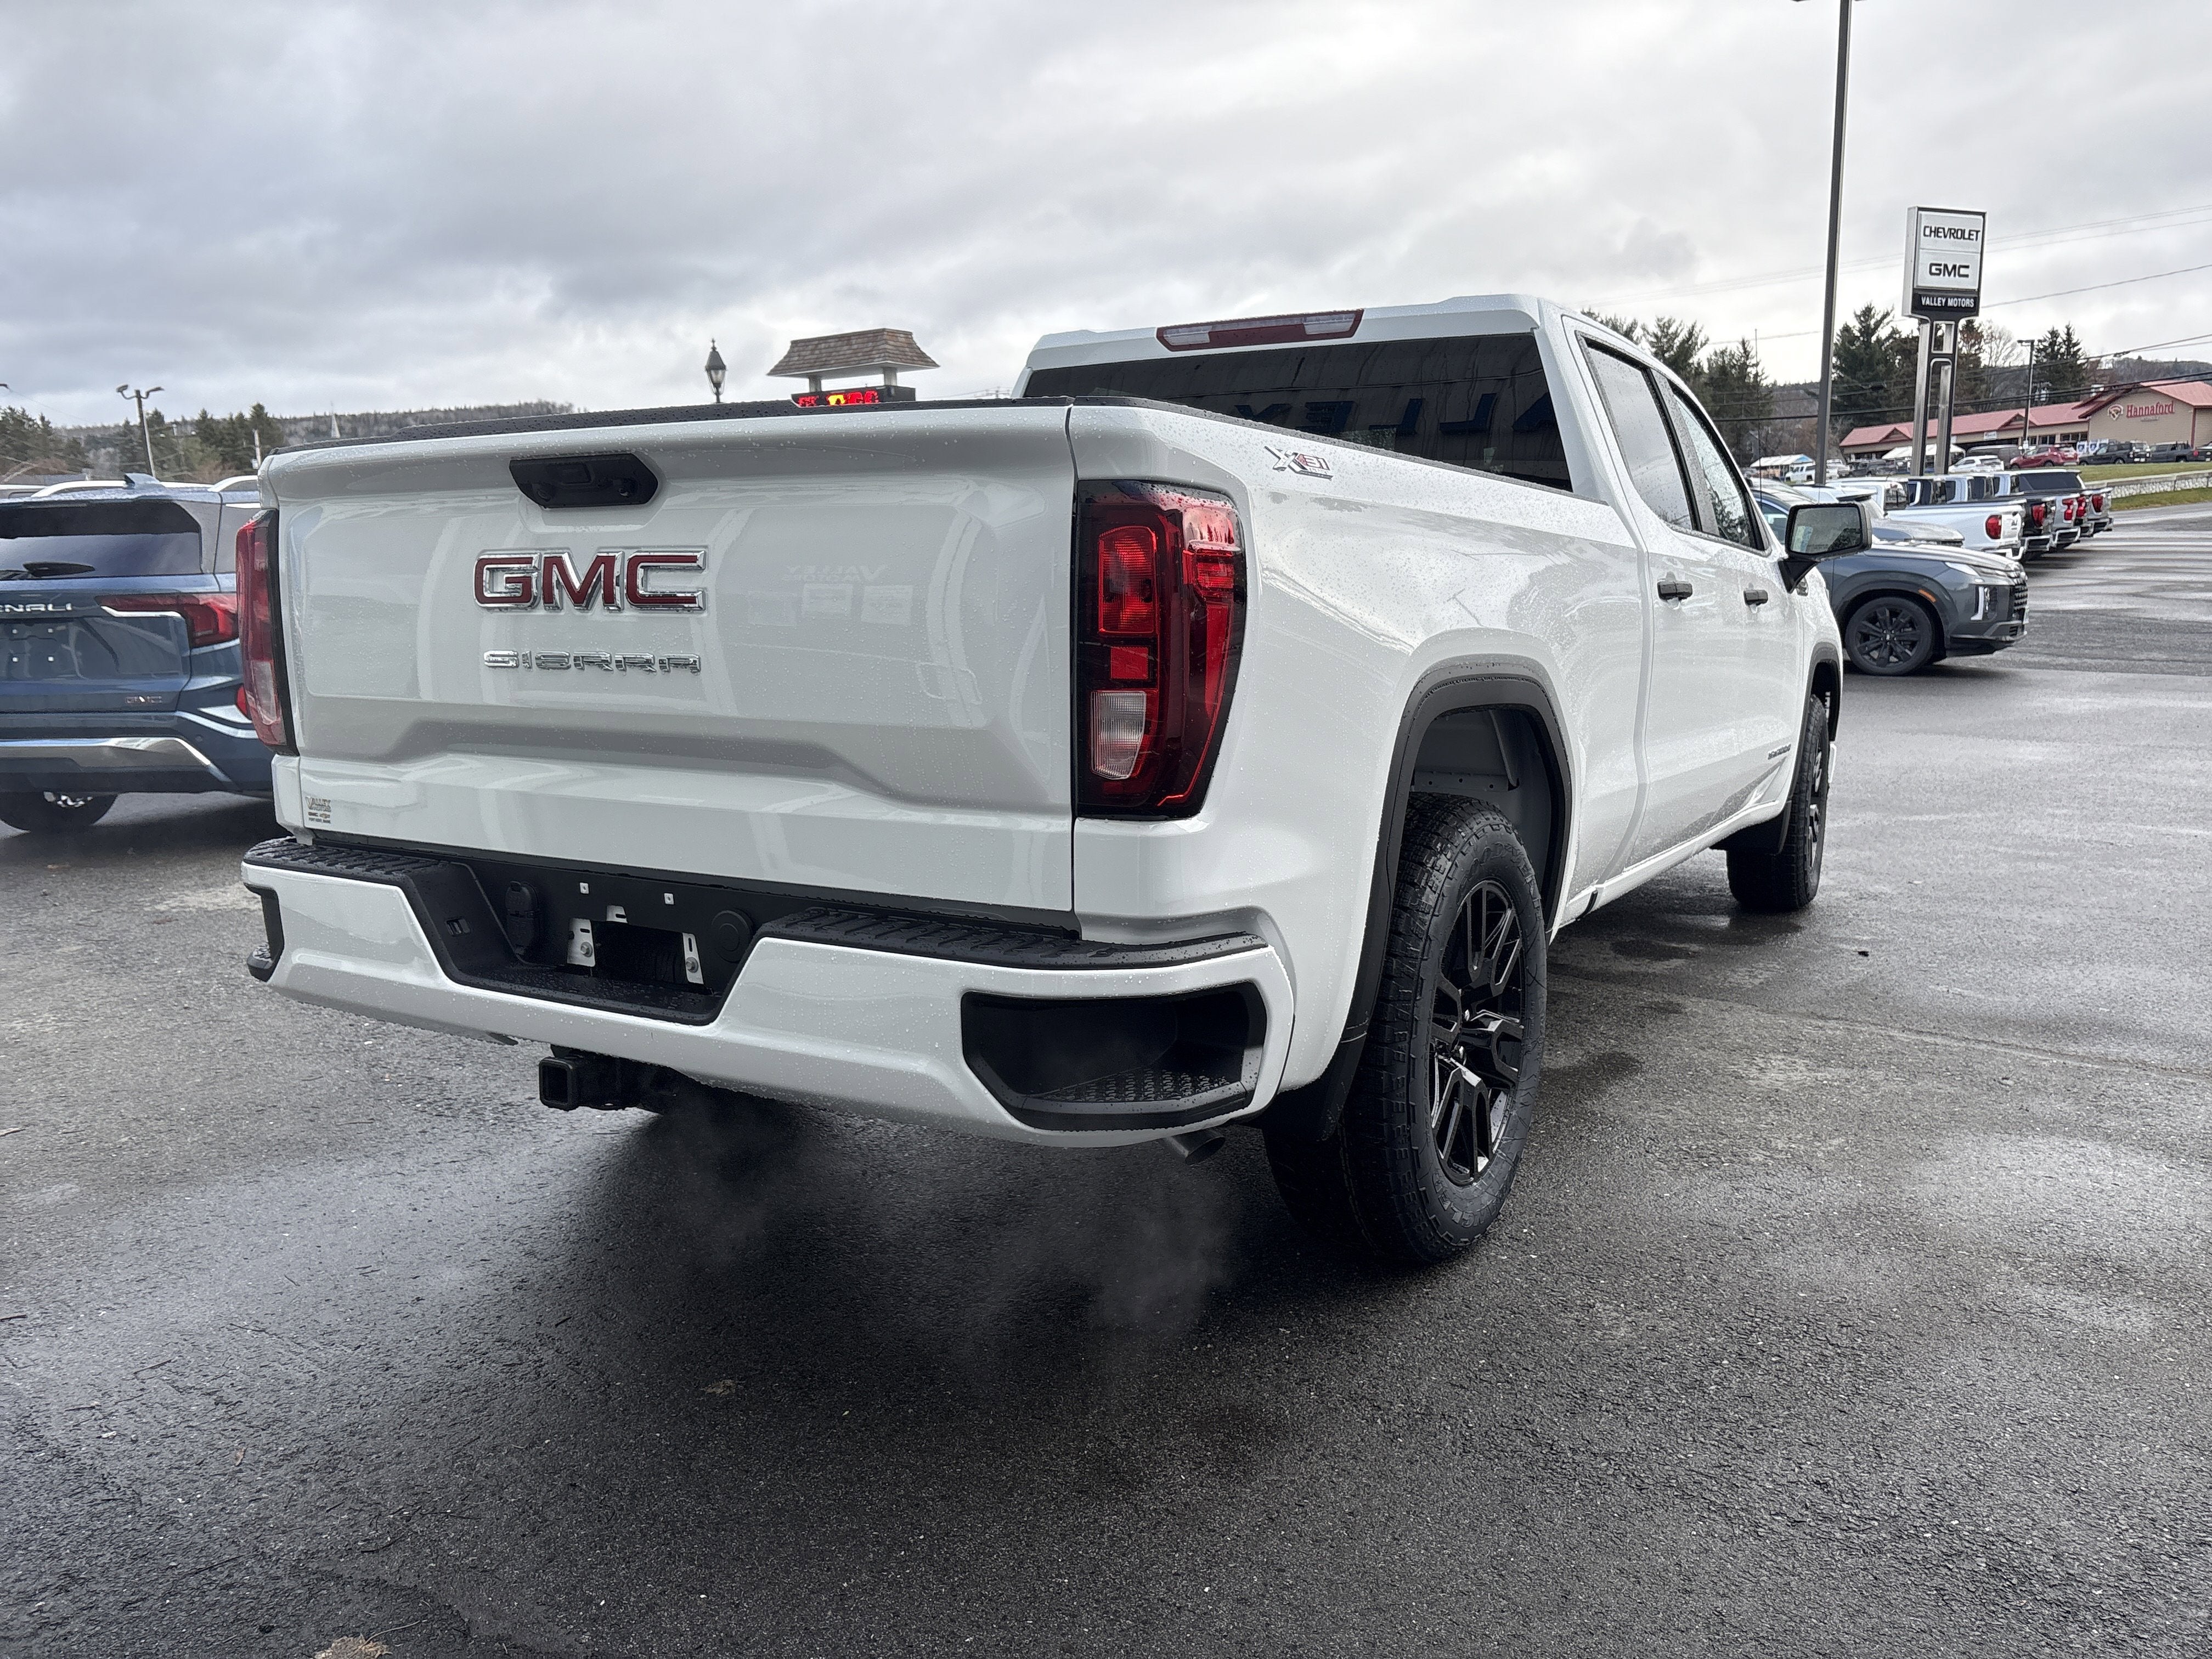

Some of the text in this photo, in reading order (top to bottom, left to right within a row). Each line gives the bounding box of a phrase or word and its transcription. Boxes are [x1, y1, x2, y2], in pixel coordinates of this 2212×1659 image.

[1923, 225, 1980, 241] CHEVROLET
[1929, 263, 1970, 278] GMC
[1921, 296, 1974, 308] VALLEY MOTORS
[2126, 400, 2175, 419] Hannaford
[1264, 445, 1334, 480] X31
[473, 549, 707, 611] GMC
[0, 603, 72, 613] NALI
[483, 650, 702, 674] SIERRA
